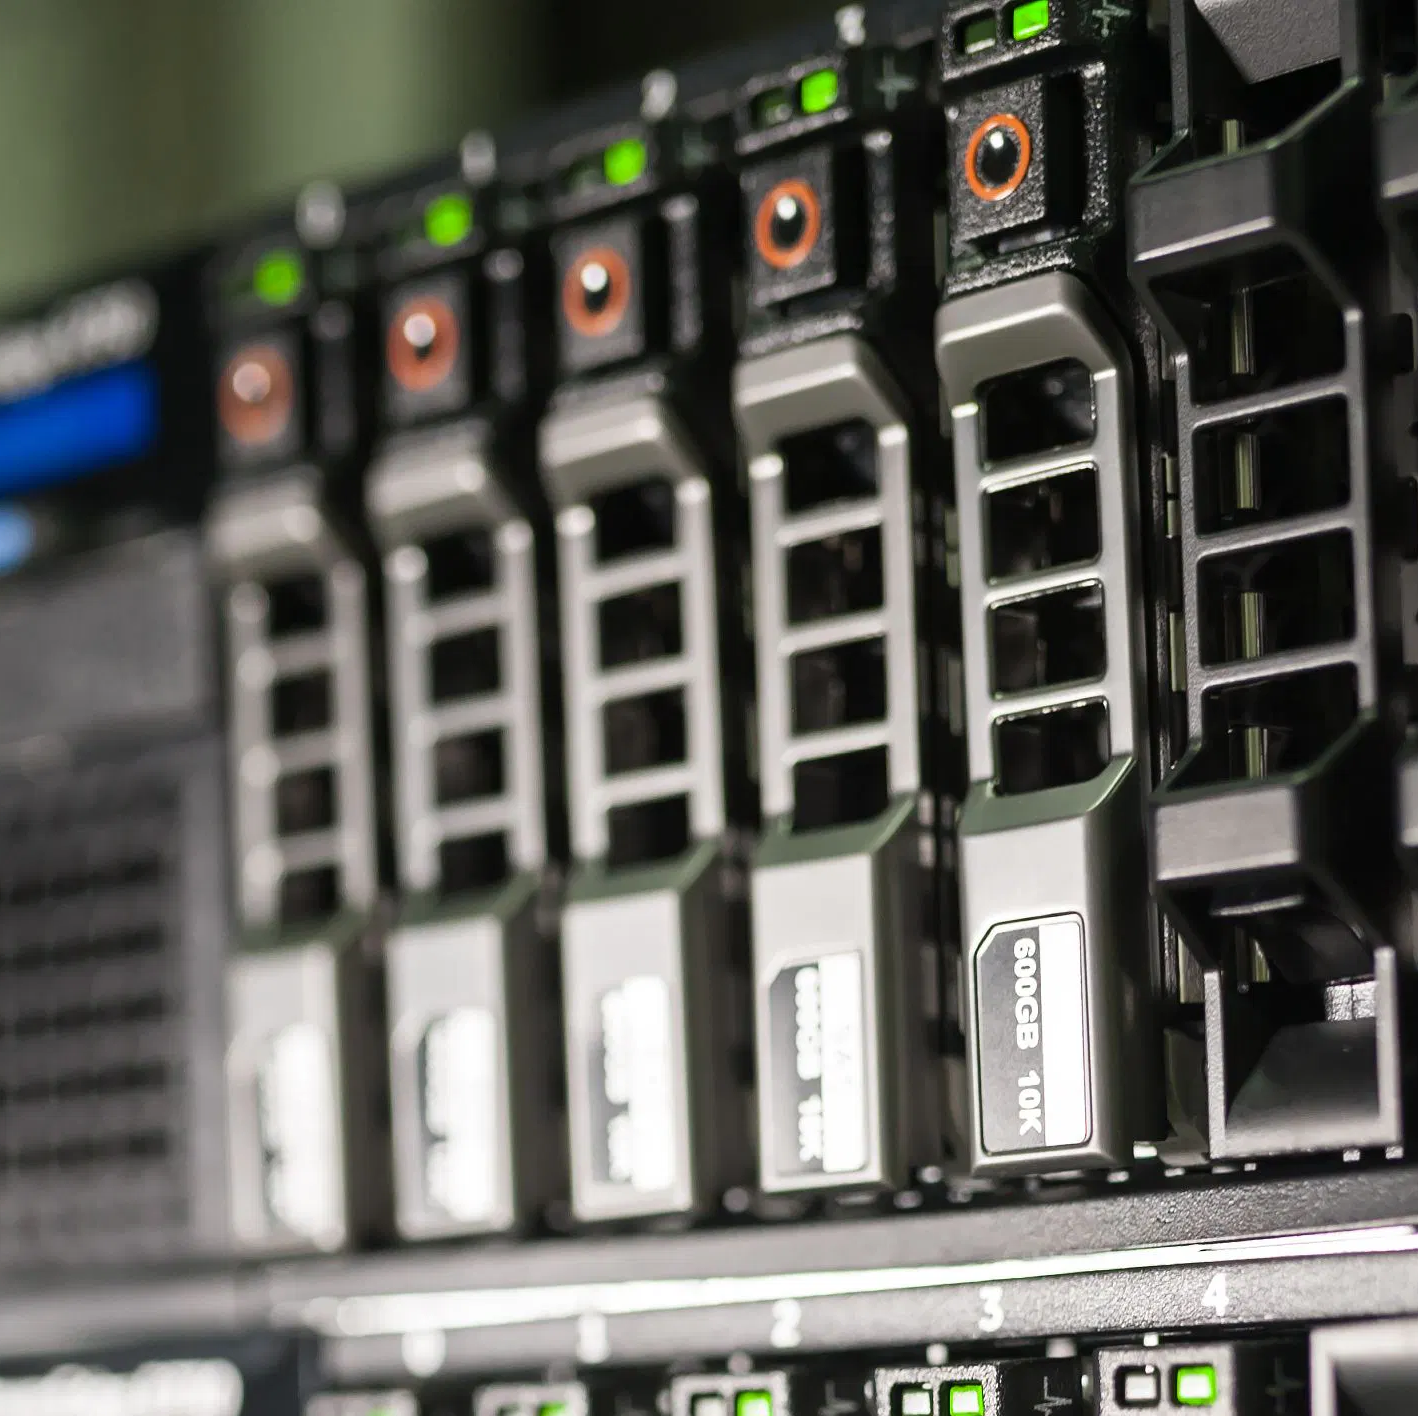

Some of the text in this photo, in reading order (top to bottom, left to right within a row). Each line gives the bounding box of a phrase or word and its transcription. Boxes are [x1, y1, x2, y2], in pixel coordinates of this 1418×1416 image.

[1014, 937, 1043, 1136] 600GB 10K
[979, 1286, 1005, 1332] 3
[1201, 1273, 1229, 1317] 4
